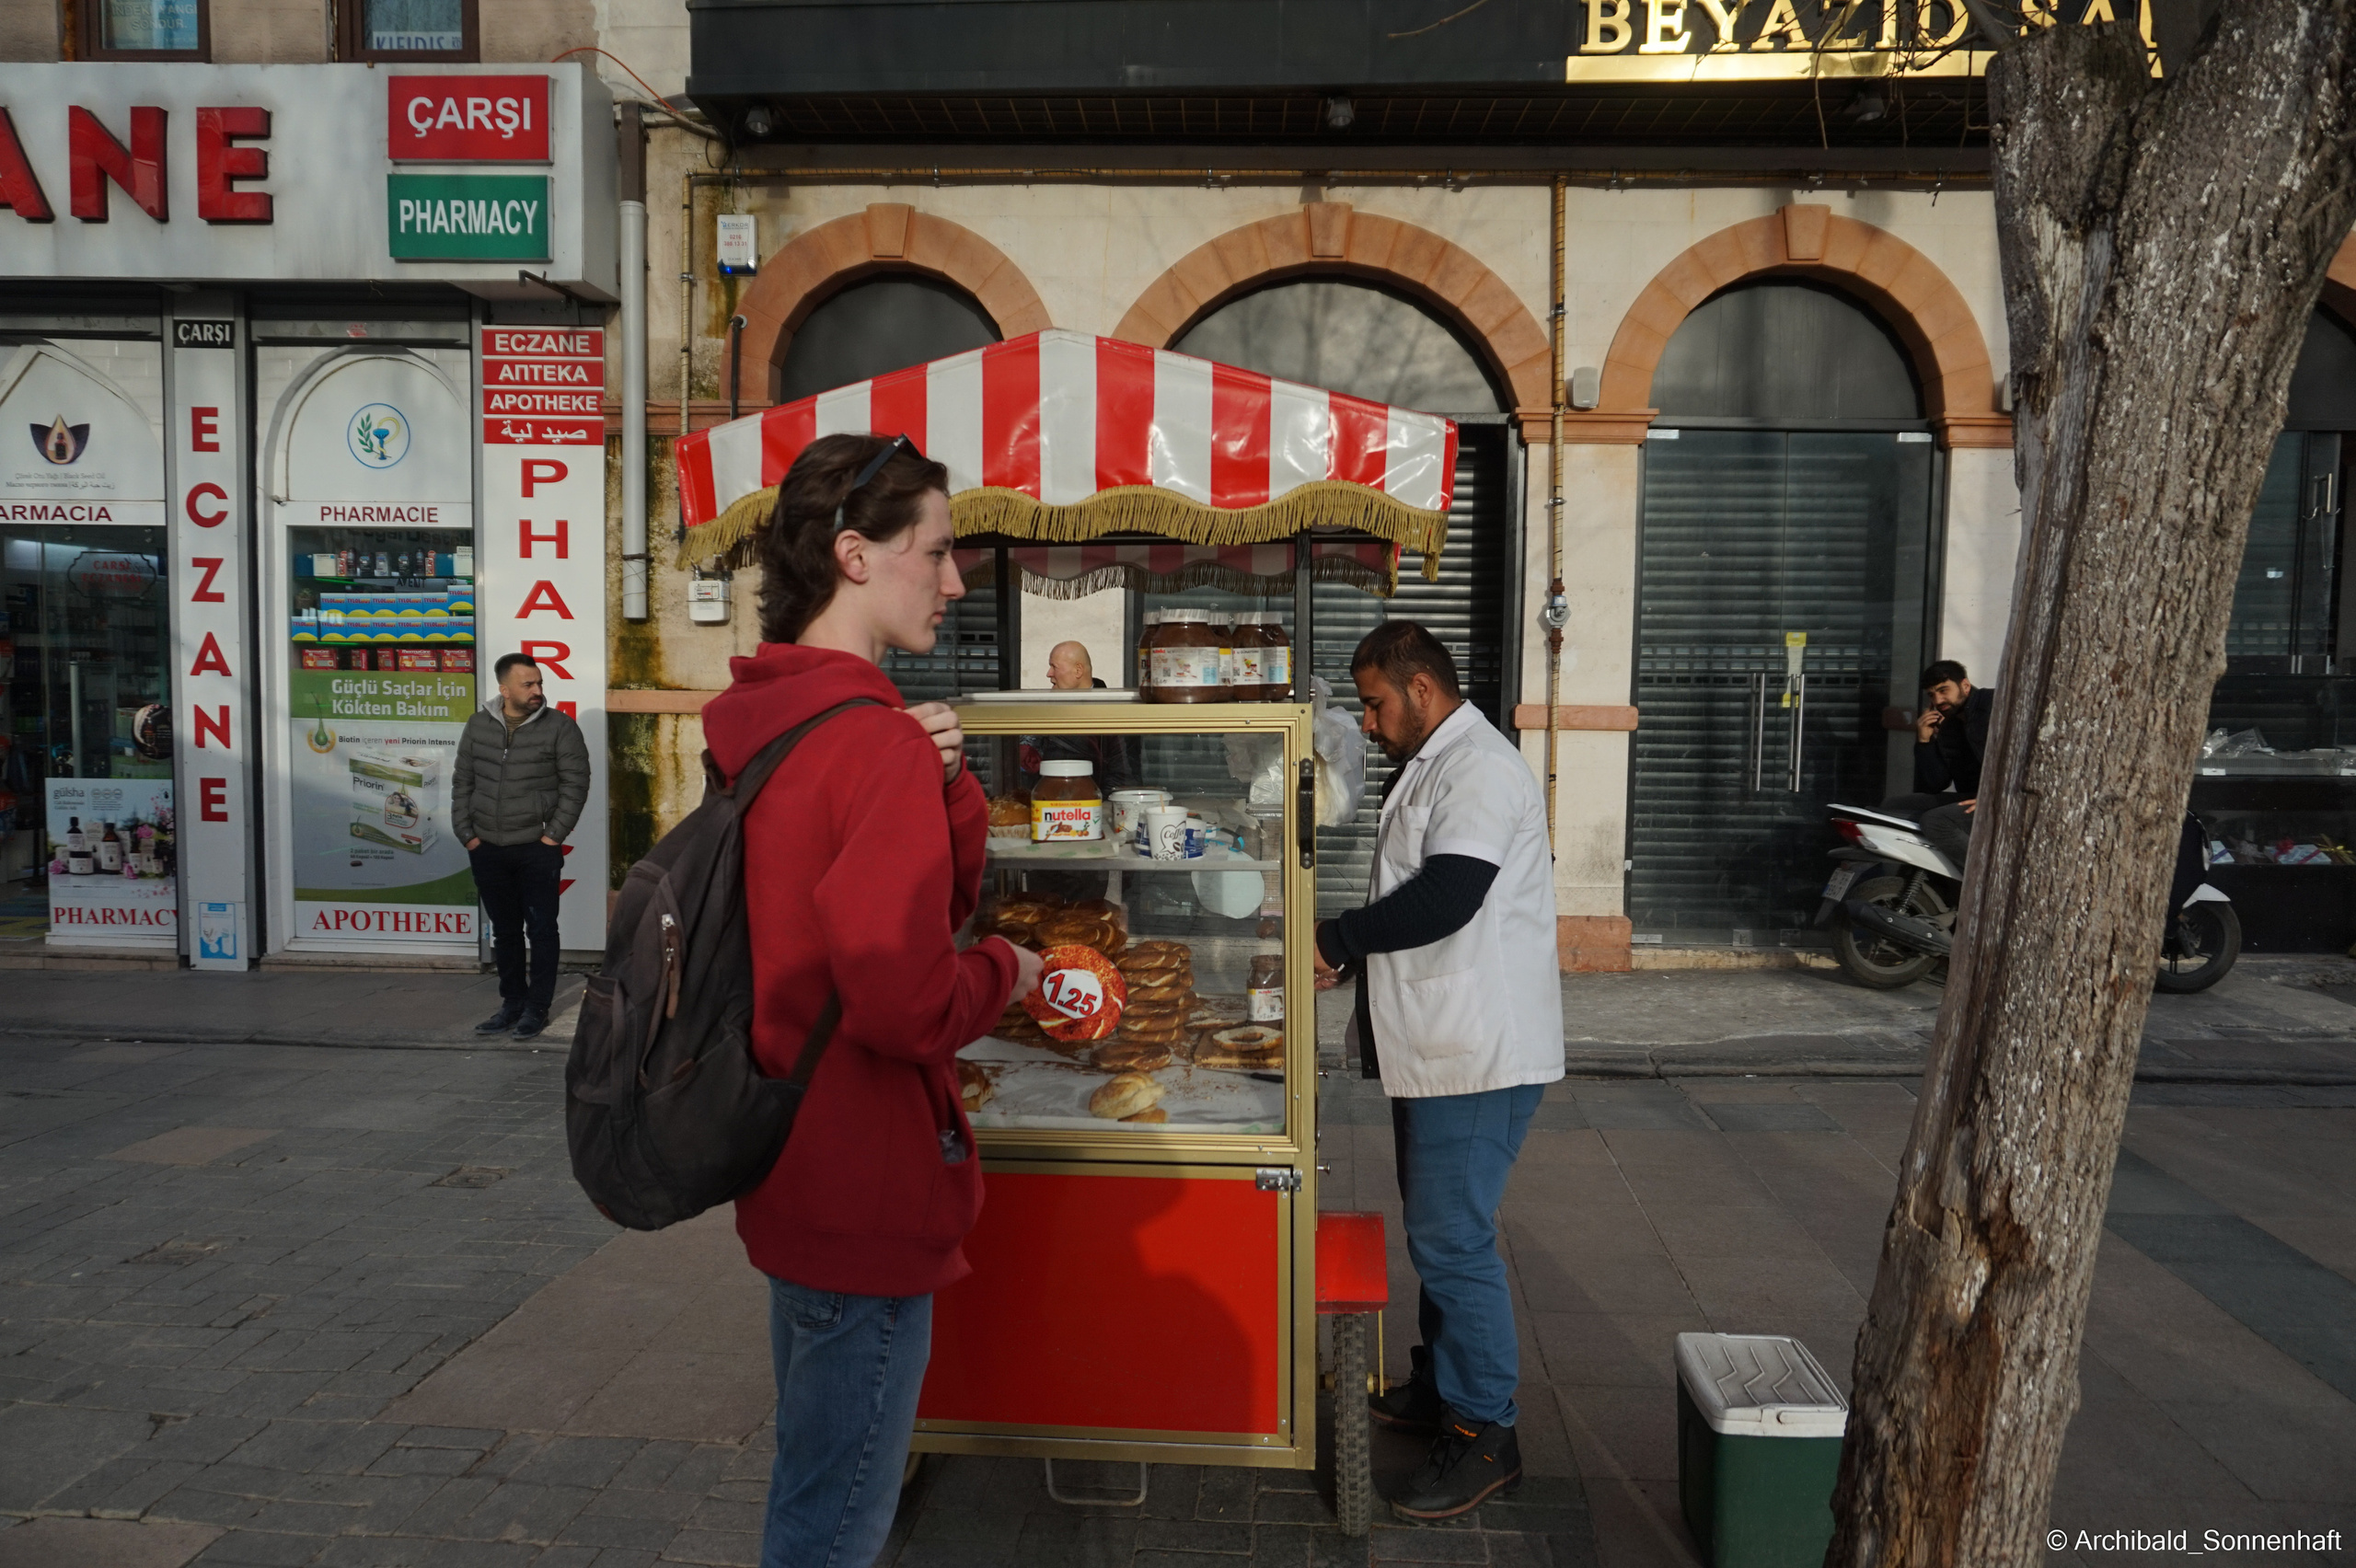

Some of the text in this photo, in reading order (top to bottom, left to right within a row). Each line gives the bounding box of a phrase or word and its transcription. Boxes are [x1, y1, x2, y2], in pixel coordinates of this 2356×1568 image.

[407, 96, 531, 139] ÇARŞI
[398, 199, 538, 235] PHARMACY
[178, 323, 230, 345] ÇARŞI
[494, 333, 590, 352] ECZANE
[498, 363, 588, 382] АПТЕКА
[490, 394, 597, 411] APOTHEKE
[541, 426, 587, 443] صيد
[320, 506, 439, 523] PHARMACIE
[186, 407, 232, 823] ECZANE
[331, 677, 467, 700] Güçlü Saçlar İçin
[332, 699, 449, 717] Kökten Bakım
[339, 735, 361, 744] Biotin
[384, 737, 400, 745] yeni
[401, 737, 427, 745] Priorin
[353, 777, 384, 790] Priorin
[1045, 808, 1091, 821] nutella
[312, 909, 471, 934] APOTHEKE
[1047, 973, 1097, 1016] 1.25
